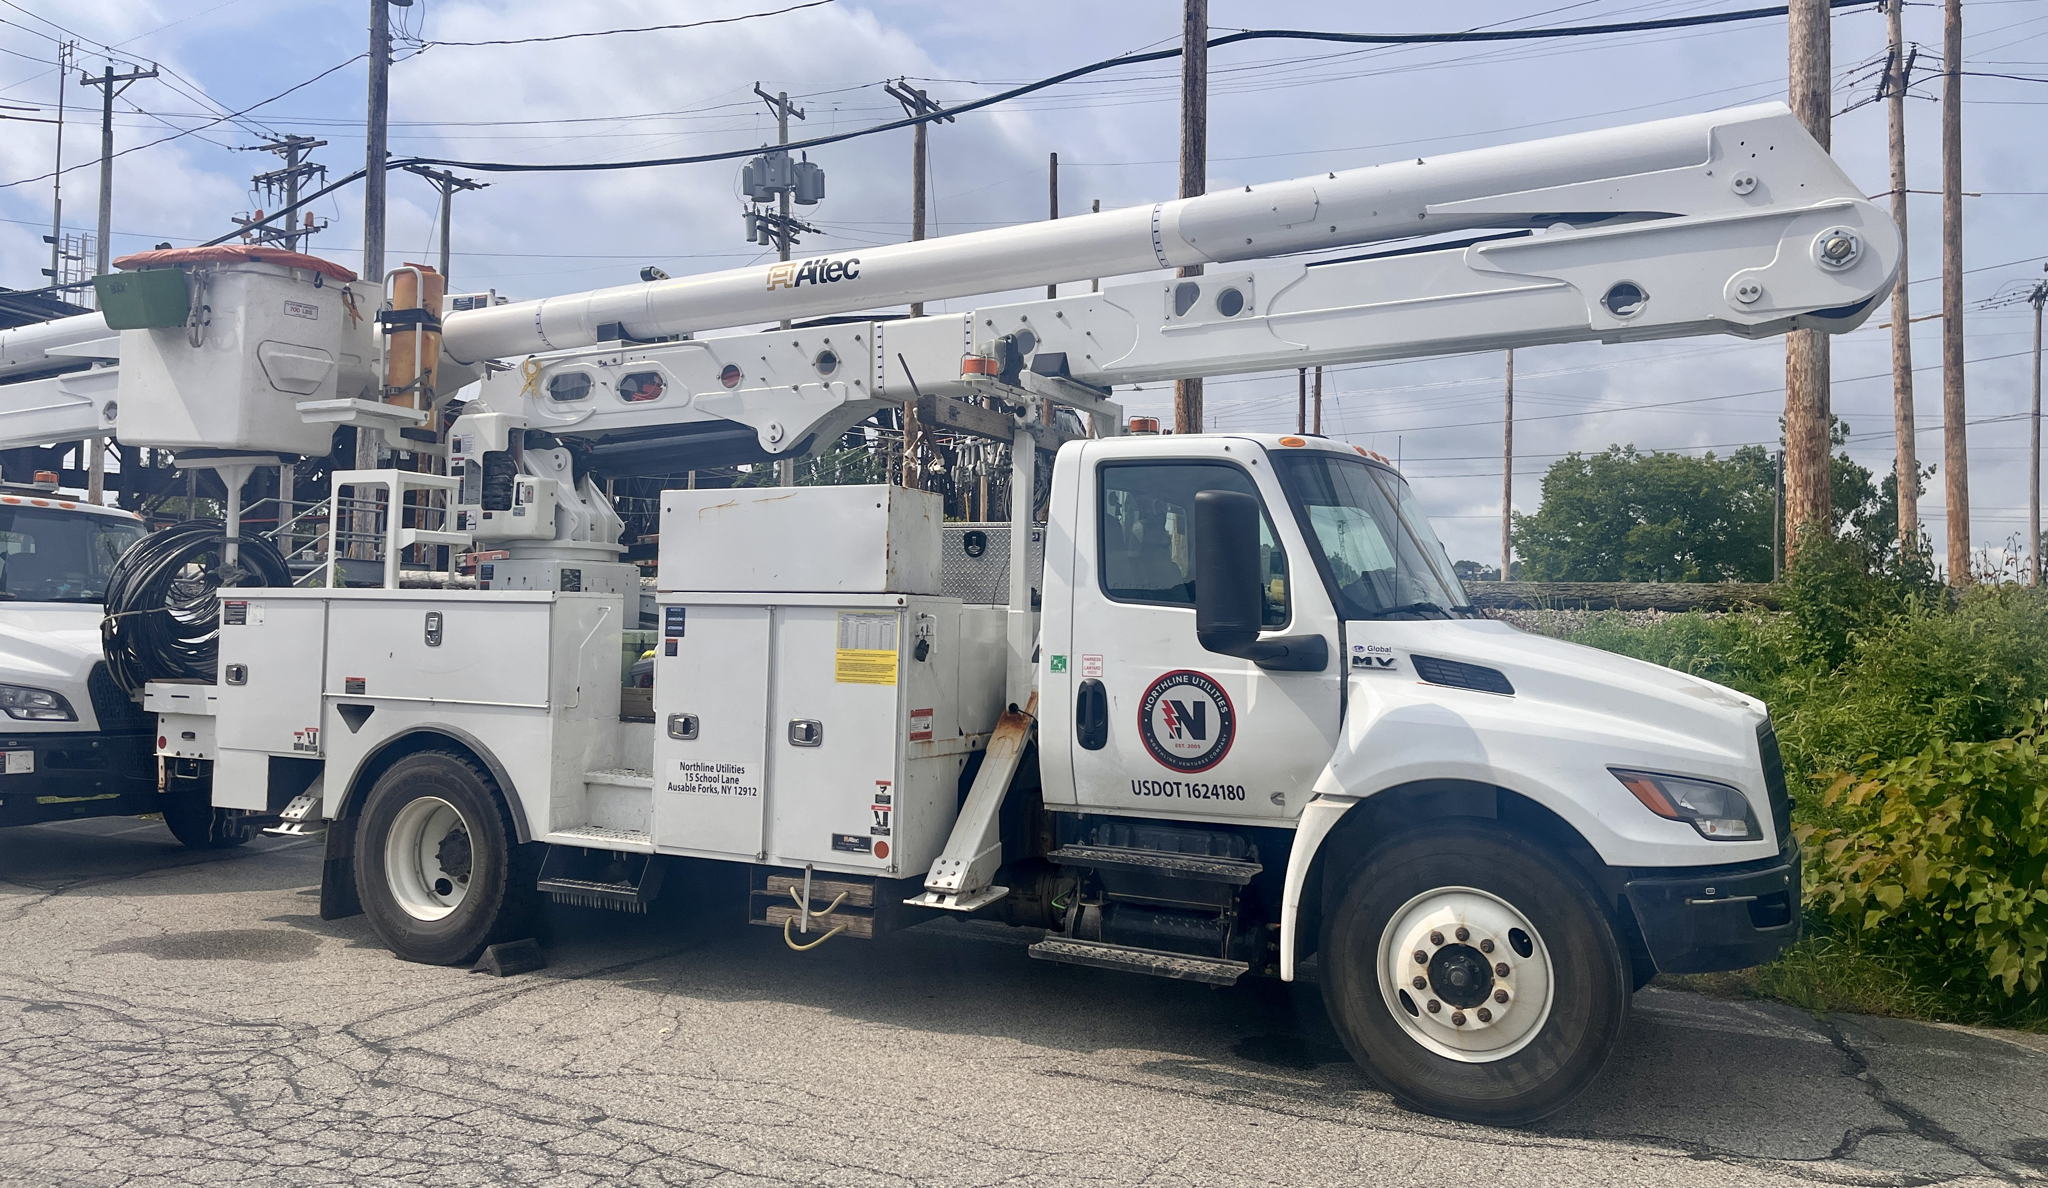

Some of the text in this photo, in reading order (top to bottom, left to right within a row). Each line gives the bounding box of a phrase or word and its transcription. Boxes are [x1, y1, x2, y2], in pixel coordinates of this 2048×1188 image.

[794, 258, 860, 287] Altec
[1367, 645, 1392, 653] Global
[1353, 656, 1395, 666] MV
[1144, 675, 1229, 714] NORTHLINE UTILITIES
[1161, 699, 1206, 741] N
[1150, 738, 1176, 763] NORTHLINE
[1209, 734, 1228, 759] COMPANY
[679, 761, 745, 775] Northline Utilities
[685, 772, 740, 785] 15 School Lane
[667, 781, 757, 797] Ausable Forks, NY 12912
[1131, 779, 1246, 801] USDOT 1624180
